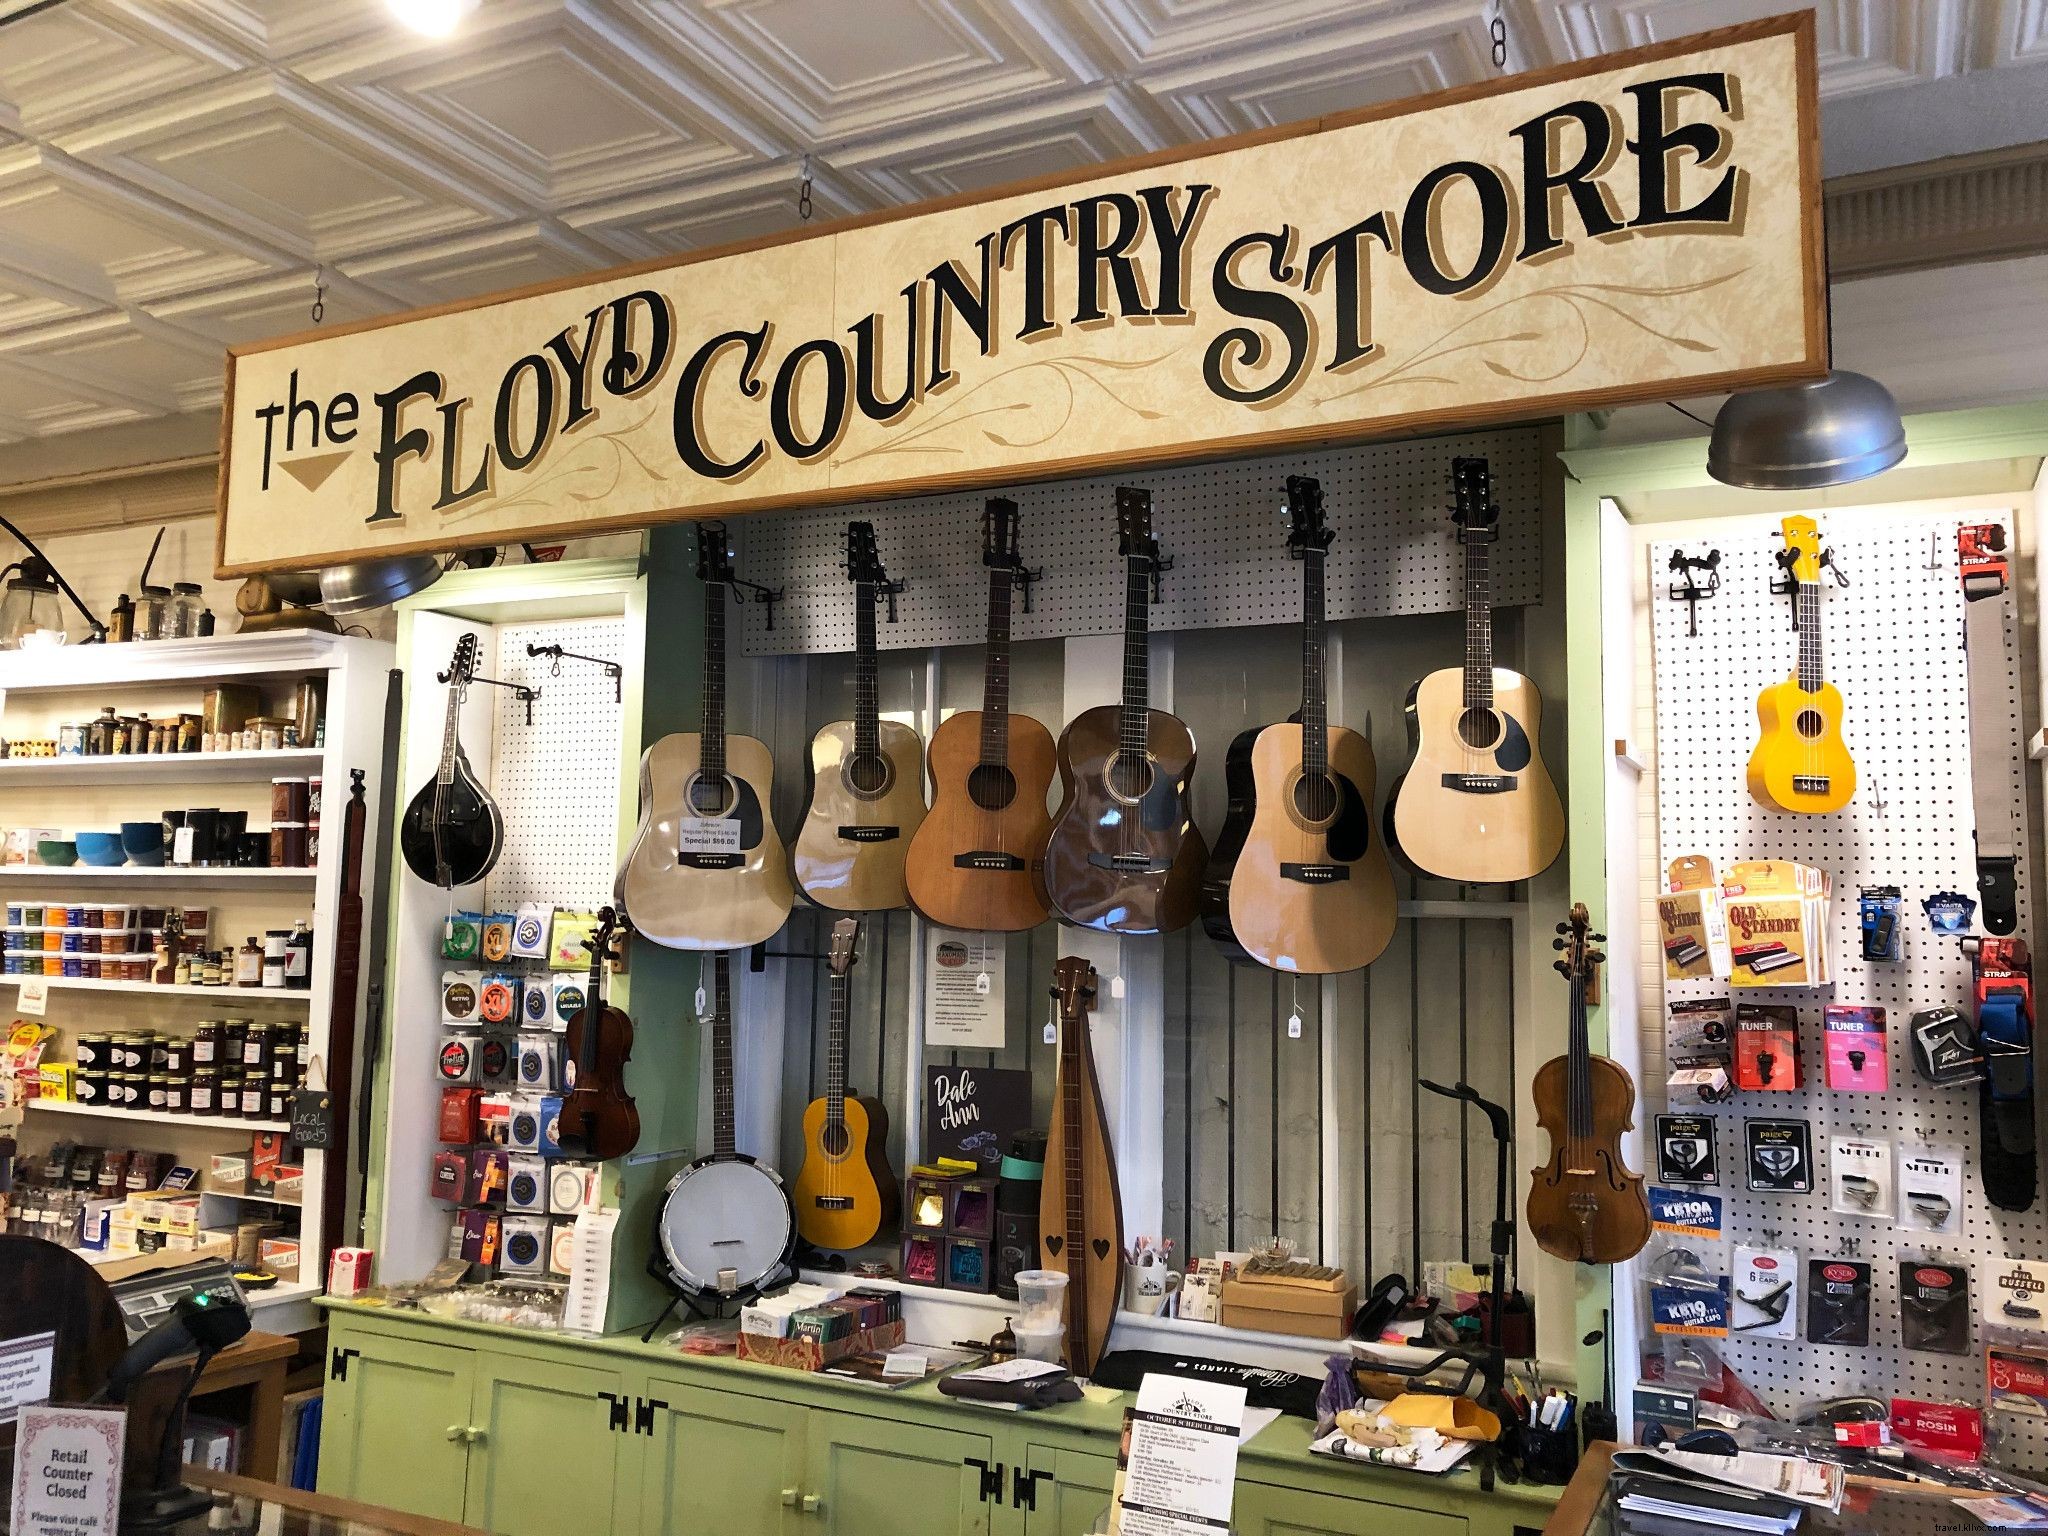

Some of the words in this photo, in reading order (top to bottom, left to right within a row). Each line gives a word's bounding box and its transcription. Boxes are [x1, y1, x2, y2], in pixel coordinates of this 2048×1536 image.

[255, 368, 358, 491] the
[365, 289, 674, 526] FLOYD
[673, 184, 1213, 480] COUNTRY
[1202, 72, 1742, 406] STORE
[1962, 557, 1990, 566] STRAP
[685, 837, 710, 845] Special
[1726, 886, 1742, 894] FREE
[1730, 906, 1757, 926] OLD
[1668, 912, 1701, 934] STANDBY
[1741, 918, 1800, 940] STANDBY
[1741, 1022, 1773, 1031] TUNER
[1829, 1022, 1864, 1032] TUNER
[935, 1070, 977, 1106] Dale
[941, 1100, 979, 1130] Ann
[1670, 1124, 1691, 1132] paige
[1760, 1131, 1782, 1139] paige
[1676, 1219, 1698, 1227] GUITAR
[1749, 1271, 1756, 1282] 6
[1759, 1277, 1779, 1285] CAPO
[1826, 1282, 1835, 1294] 12
[2001, 1277, 2043, 1290] RUSSELL
[1683, 1318, 1706, 1327] GUITAR
[1705, 1314, 1722, 1323] CAPO
[796, 1321, 821, 1334] Martin
[25, 1365, 40, 1375] and
[6, 1381, 16, 1390] of
[17, 1379, 34, 1389] your
[1163, 1408, 1192, 1418] COUNTRY
[1193, 1411, 1213, 1421] STORE
[1147, 1414, 1177, 1425] OCTOBER
[1178, 1420, 1213, 1431] SCHEDULE
[1214, 1425, 1227, 1434] 2019
[1916, 1420, 1957, 1432] ROSIN
[51, 1449, 88, 1464] Retail
[43, 1465, 94, 1481] Counter
[46, 1483, 87, 1499] Closed
[31, 1511, 58, 1523] Please
[59, 1514, 78, 1525] visit
[1142, 1505, 1169, 1517] UPCOMING
[1169, 1510, 1188, 1521] SPECIAL
[1189, 1515, 1208, 1524] EVENTS
[40, 1527, 73, 1536] register
[74, 1528, 88, 1536] for
